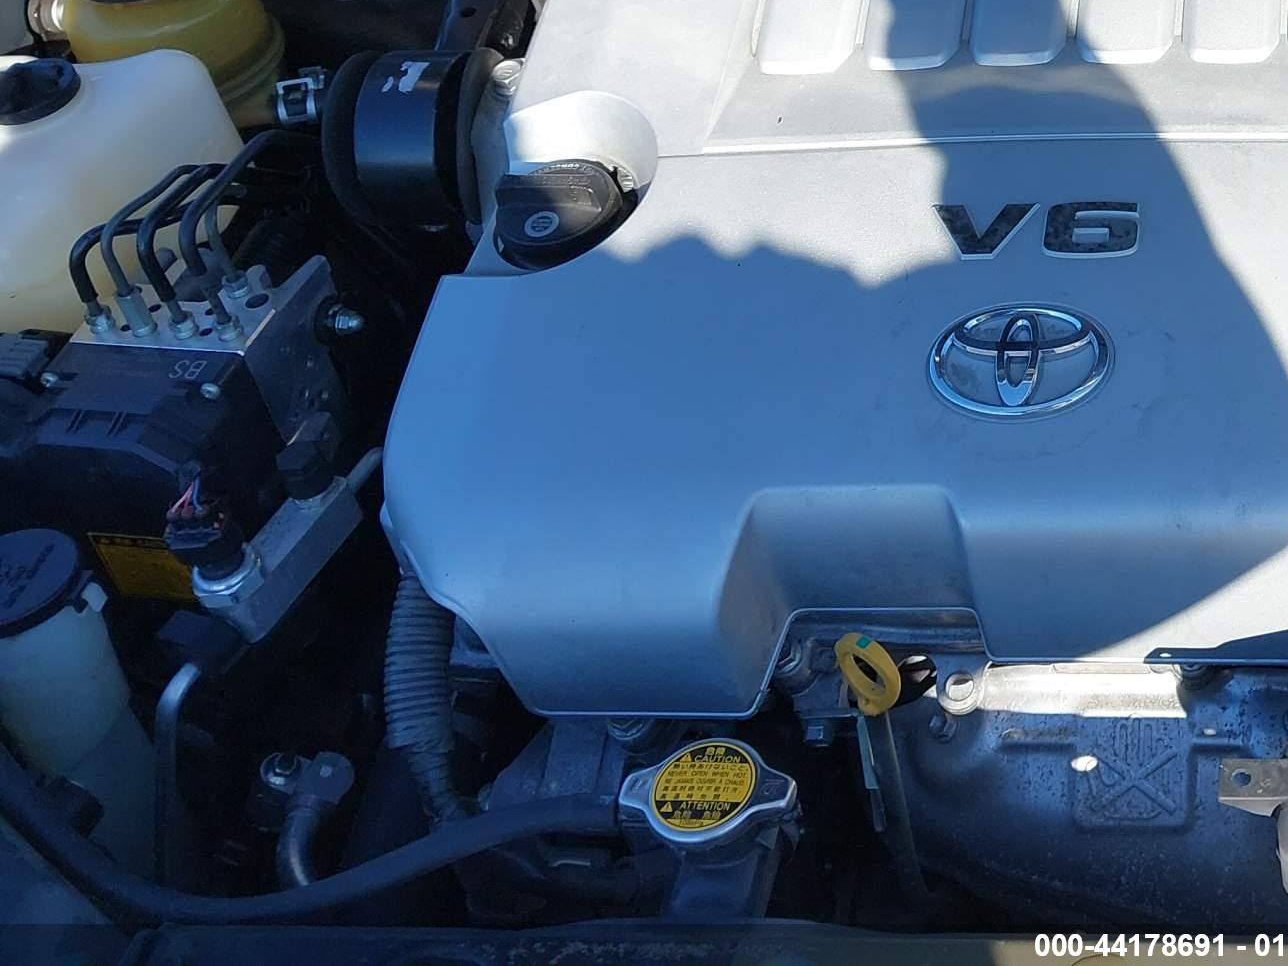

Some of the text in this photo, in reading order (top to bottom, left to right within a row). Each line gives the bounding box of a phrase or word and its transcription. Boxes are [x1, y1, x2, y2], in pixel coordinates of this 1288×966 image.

[932, 202, 1140, 260] V6
[694, 755, 741, 763] CAUTION
[680, 801, 731, 811] ATTENTION
